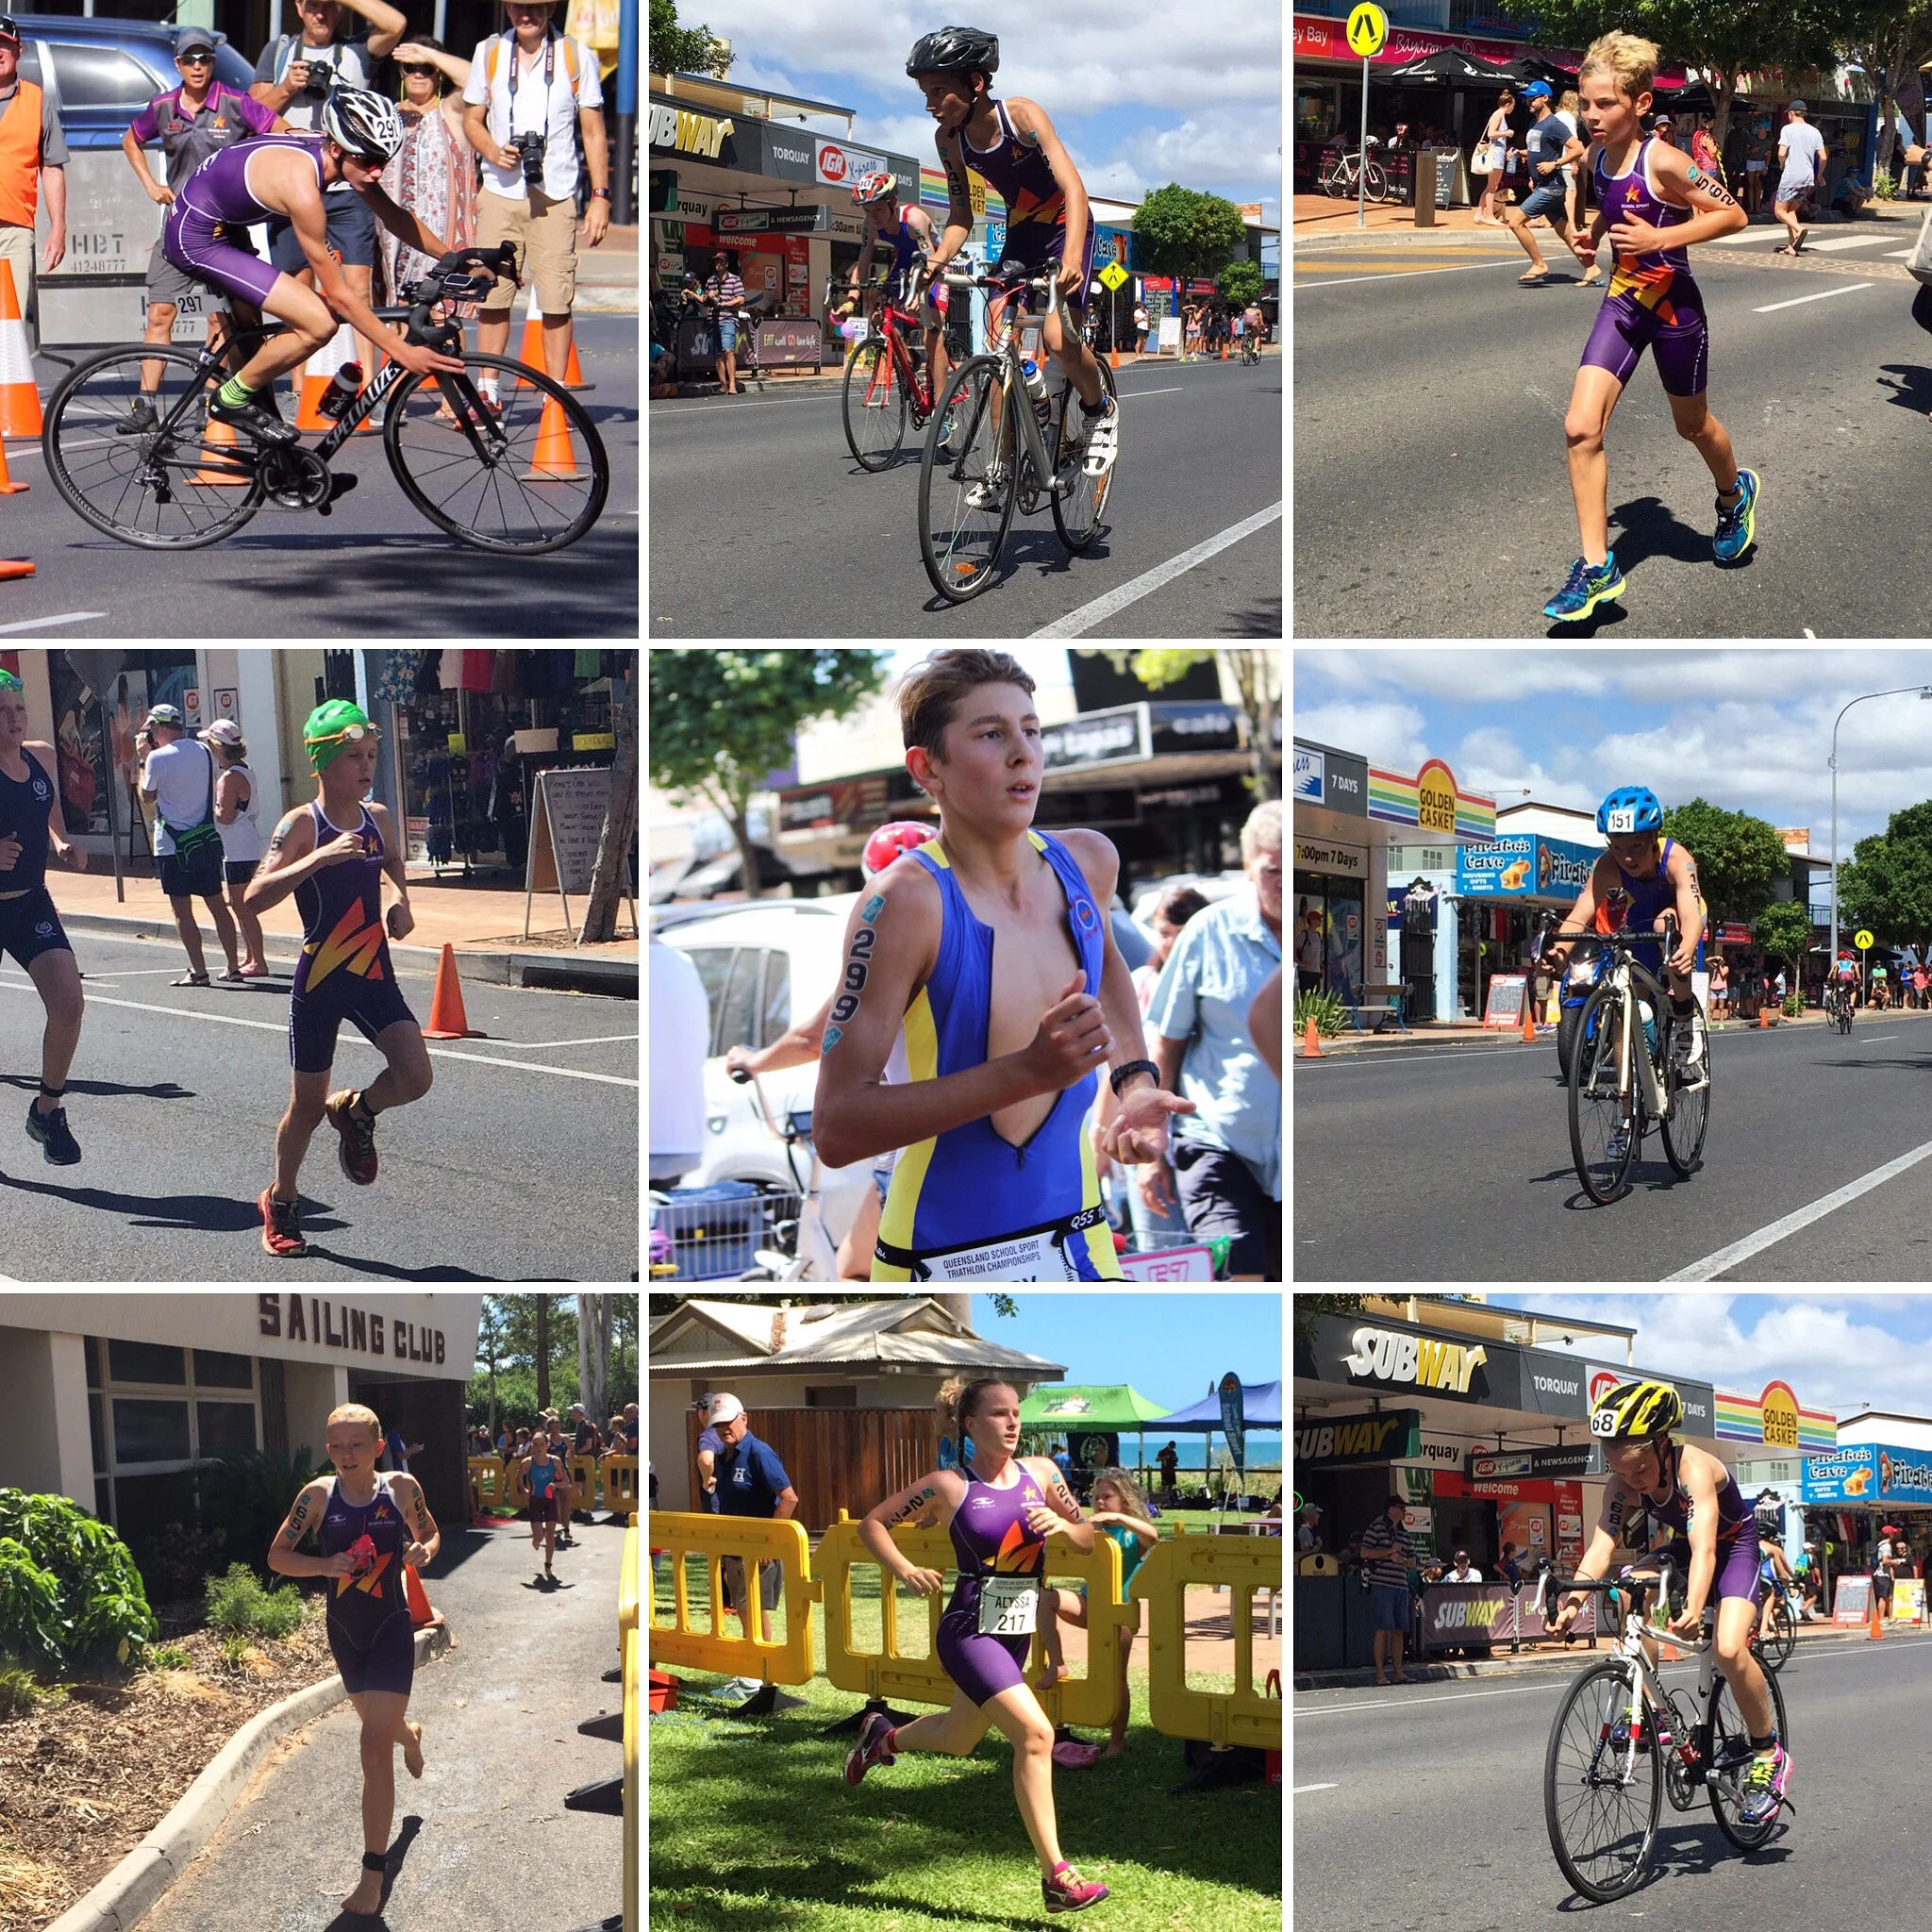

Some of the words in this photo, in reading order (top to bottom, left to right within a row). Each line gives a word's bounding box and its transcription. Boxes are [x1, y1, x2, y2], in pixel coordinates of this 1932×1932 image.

[1307, 26, 1328, 47] Bay
[772, 145, 810, 165] TORQUAY
[822, 151, 843, 174] IGA
[897, 174, 913, 187] DAYS
[723, 217, 738, 227] IGA
[776, 214, 821, 224] NEWSAGENCY
[72, 233, 124, 255] HBT
[177, 296, 203, 313] 297
[763, 334, 774, 347] EAT
[325, 361, 403, 451] SPECIALIZE
[1331, 774, 1338, 789] 7
[1338, 776, 1358, 793] DAYS
[1419, 788, 1455, 812] GOLDEN
[1419, 808, 1455, 831] CASKET
[1611, 813, 1632, 829] 151
[1330, 849, 1337, 864] 7
[1337, 852, 1358, 869] Days
[1465, 857, 1506, 870] Cave
[1689, 873, 1701, 906] 151
[831, 926, 875, 1023] 299
[1070, 1208, 1095, 1230] QSS
[942, 1251, 991, 1270] QUEENSLAND
[991, 1244, 1018, 1259] SCHOOL
[1019, 1239, 1040, 1254] SPORT
[946, 1261, 987, 1280] TRIATHLON
[987, 1251, 1041, 1273] CHAMPIONSHIPS
[258, 1293, 385, 1355] SAILING
[393, 1320, 445, 1364] CLUB
[1341, 1325, 1489, 1393] SUBWAY
[1533, 1375, 1579, 1396] TORQUAY
[1222, 1403, 1233, 1431] School
[1687, 1402, 1706, 1418] DAYS
[1763, 1408, 1797, 1427] GOLDEN
[1056, 1421, 1077, 1430] School
[1591, 1413, 1614, 1432] 68
[1227, 1432, 1241, 1456] Sport
[1293, 1416, 1400, 1459] SUBWAY
[1763, 1425, 1797, 1445] CASKET
[1476, 1462, 1494, 1473] IGA
[1541, 1454, 1594, 1467] NEWSAGENCY
[1808, 1465, 1847, 1479] Cave
[1057, 1485, 1080, 1520] 217
[994, 1596, 1030, 1609] ALYSSA
[1434, 1596, 1506, 1629] SUBWAY
[997, 1614, 1025, 1631] 217
